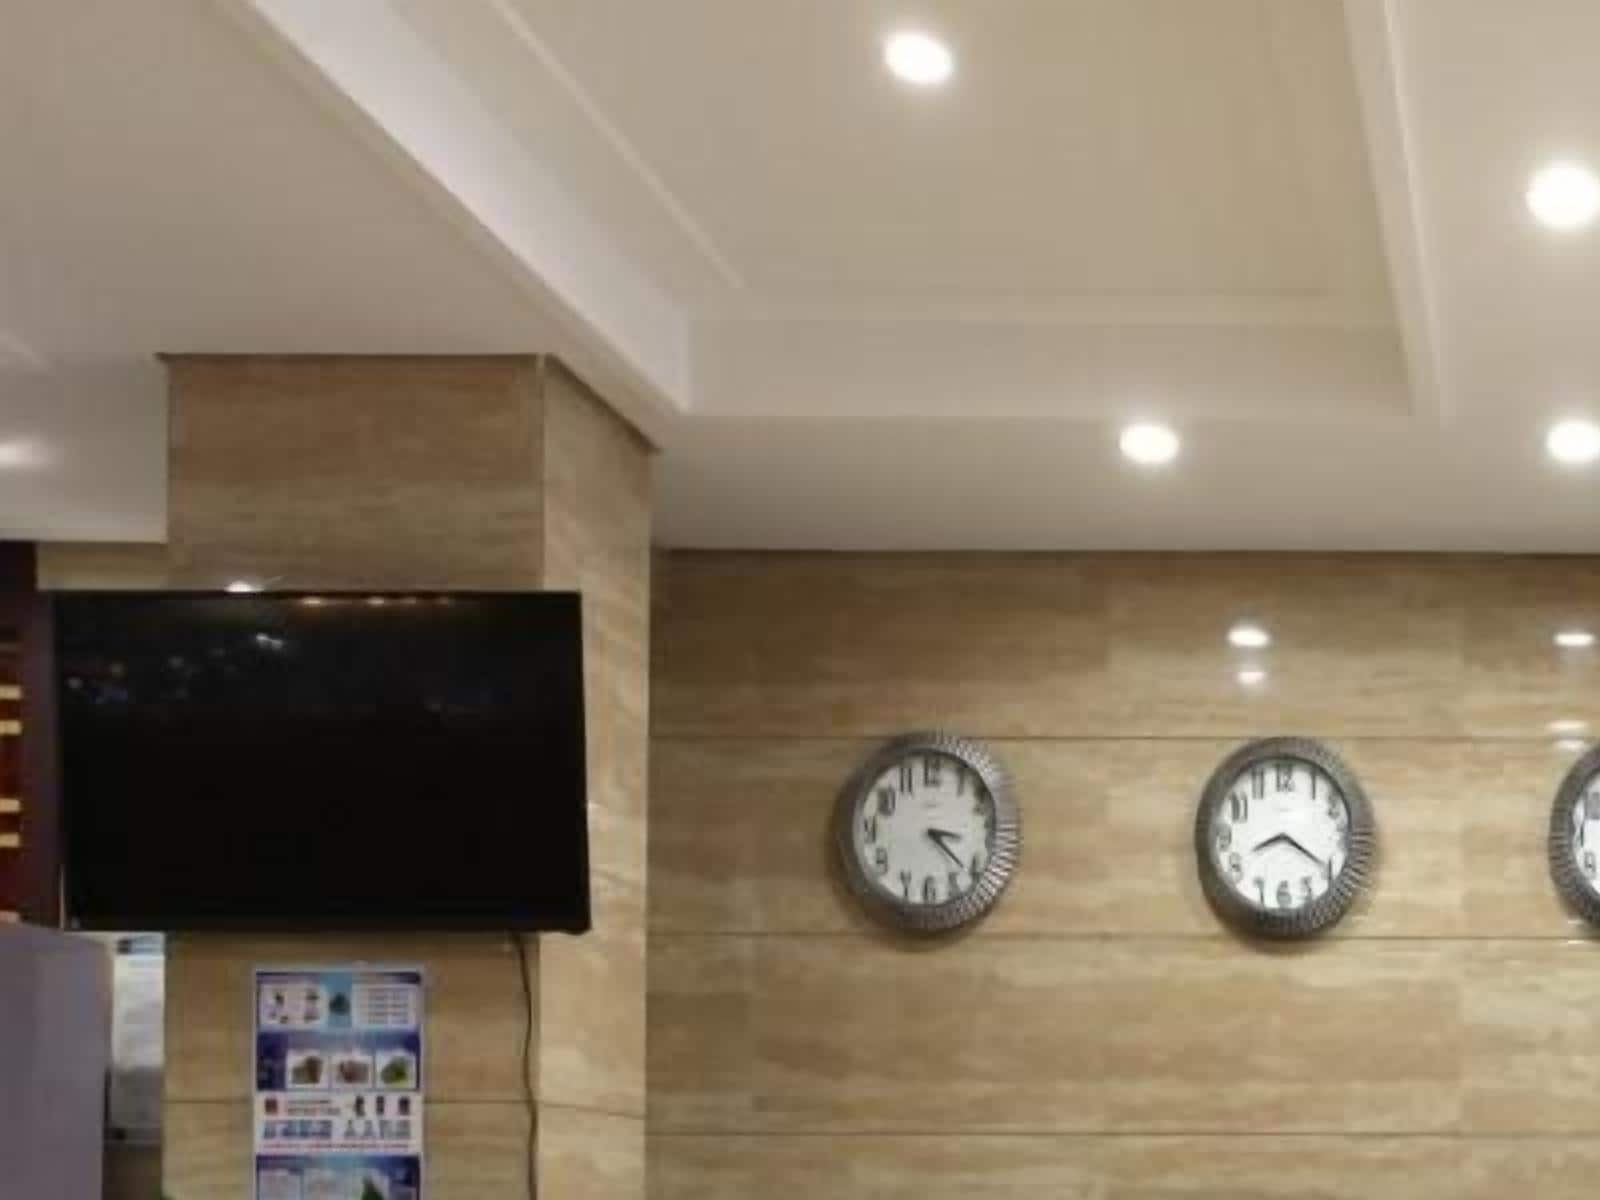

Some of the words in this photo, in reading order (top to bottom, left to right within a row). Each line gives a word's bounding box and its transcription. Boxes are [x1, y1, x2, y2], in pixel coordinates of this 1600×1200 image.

[900, 767, 913, 795] 11
[924, 755, 940, 787] 12
[1252, 768, 1264, 799] 11
[1277, 763, 1295, 792] 12
[878, 786, 895, 815] 10
[1231, 792, 1248, 823] 10
[900, 871, 912, 902] 7
[923, 875, 936, 902] 6
[1253, 877, 1265, 905] 7
[1277, 880, 1291, 907] 6
